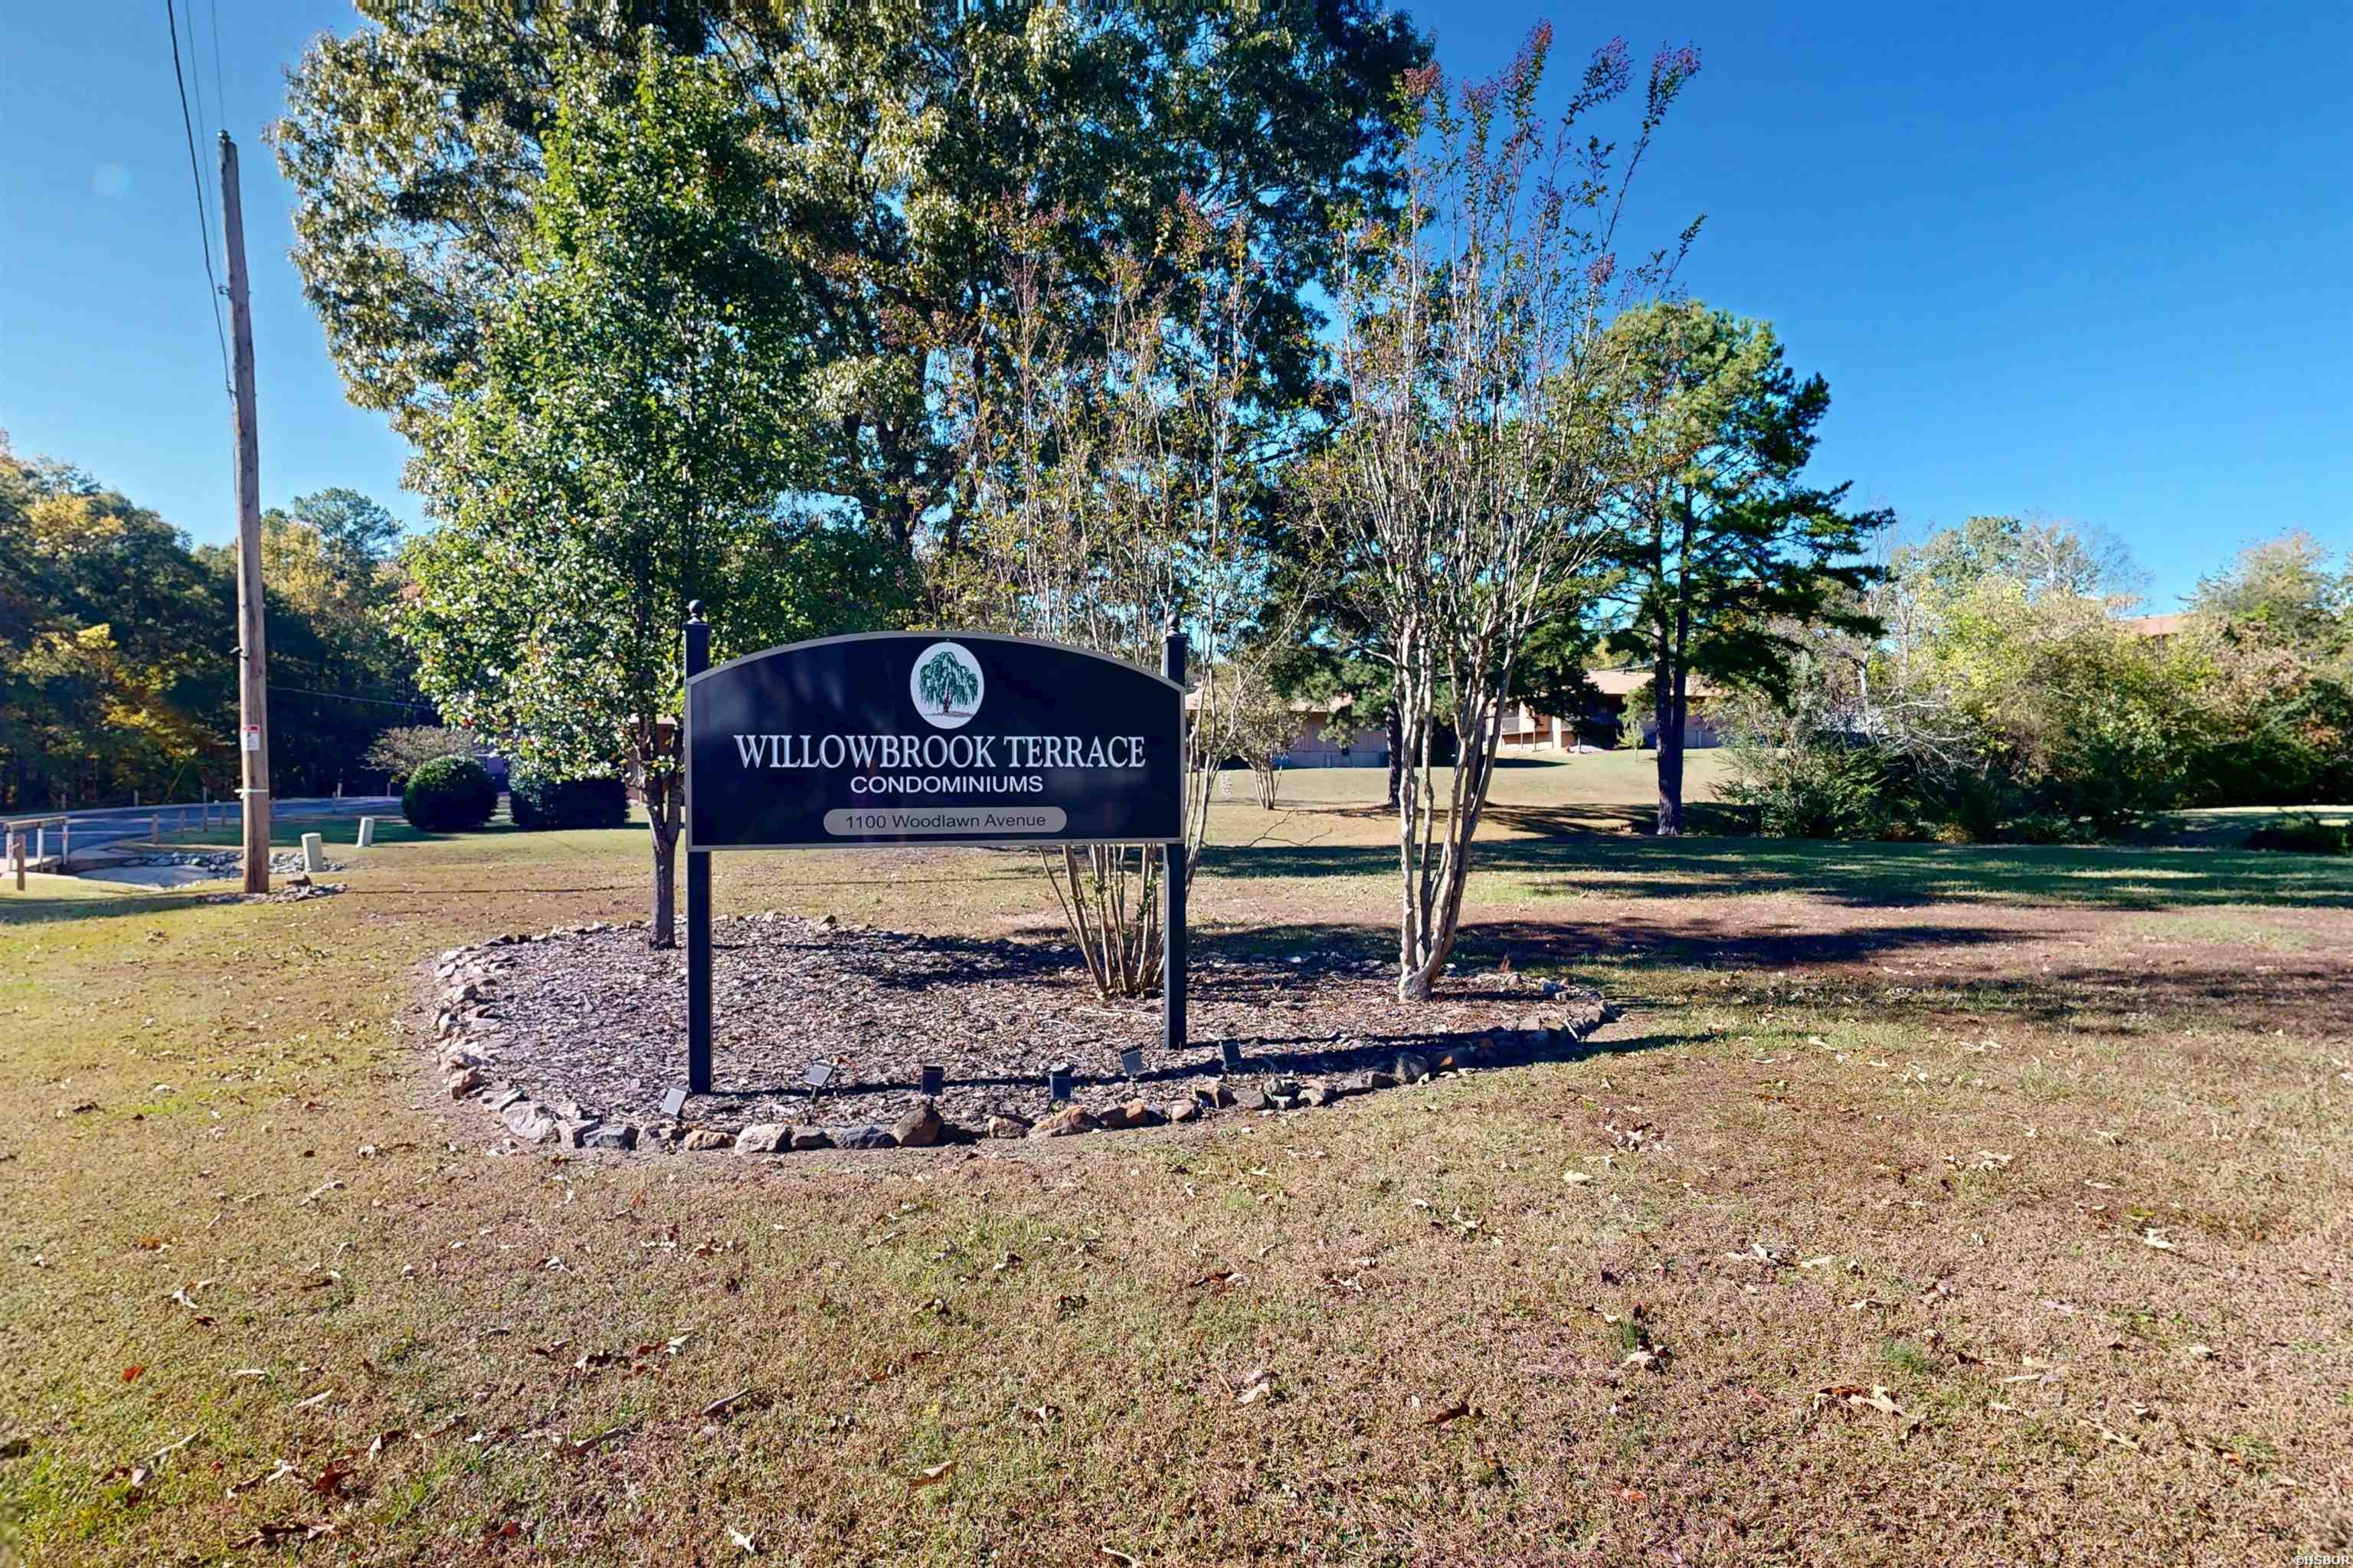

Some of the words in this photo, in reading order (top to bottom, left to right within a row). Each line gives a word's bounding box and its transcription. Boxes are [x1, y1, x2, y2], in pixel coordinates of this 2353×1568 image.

[733, 734, 997, 768] WILLOWBROOK
[1003, 735, 1146, 768] TERRACE
[850, 775, 1043, 794] CONDOMINIUMS
[846, 814, 886, 829] 1100
[892, 813, 980, 829] Woodlawn
[984, 813, 1046, 828] Avenue
